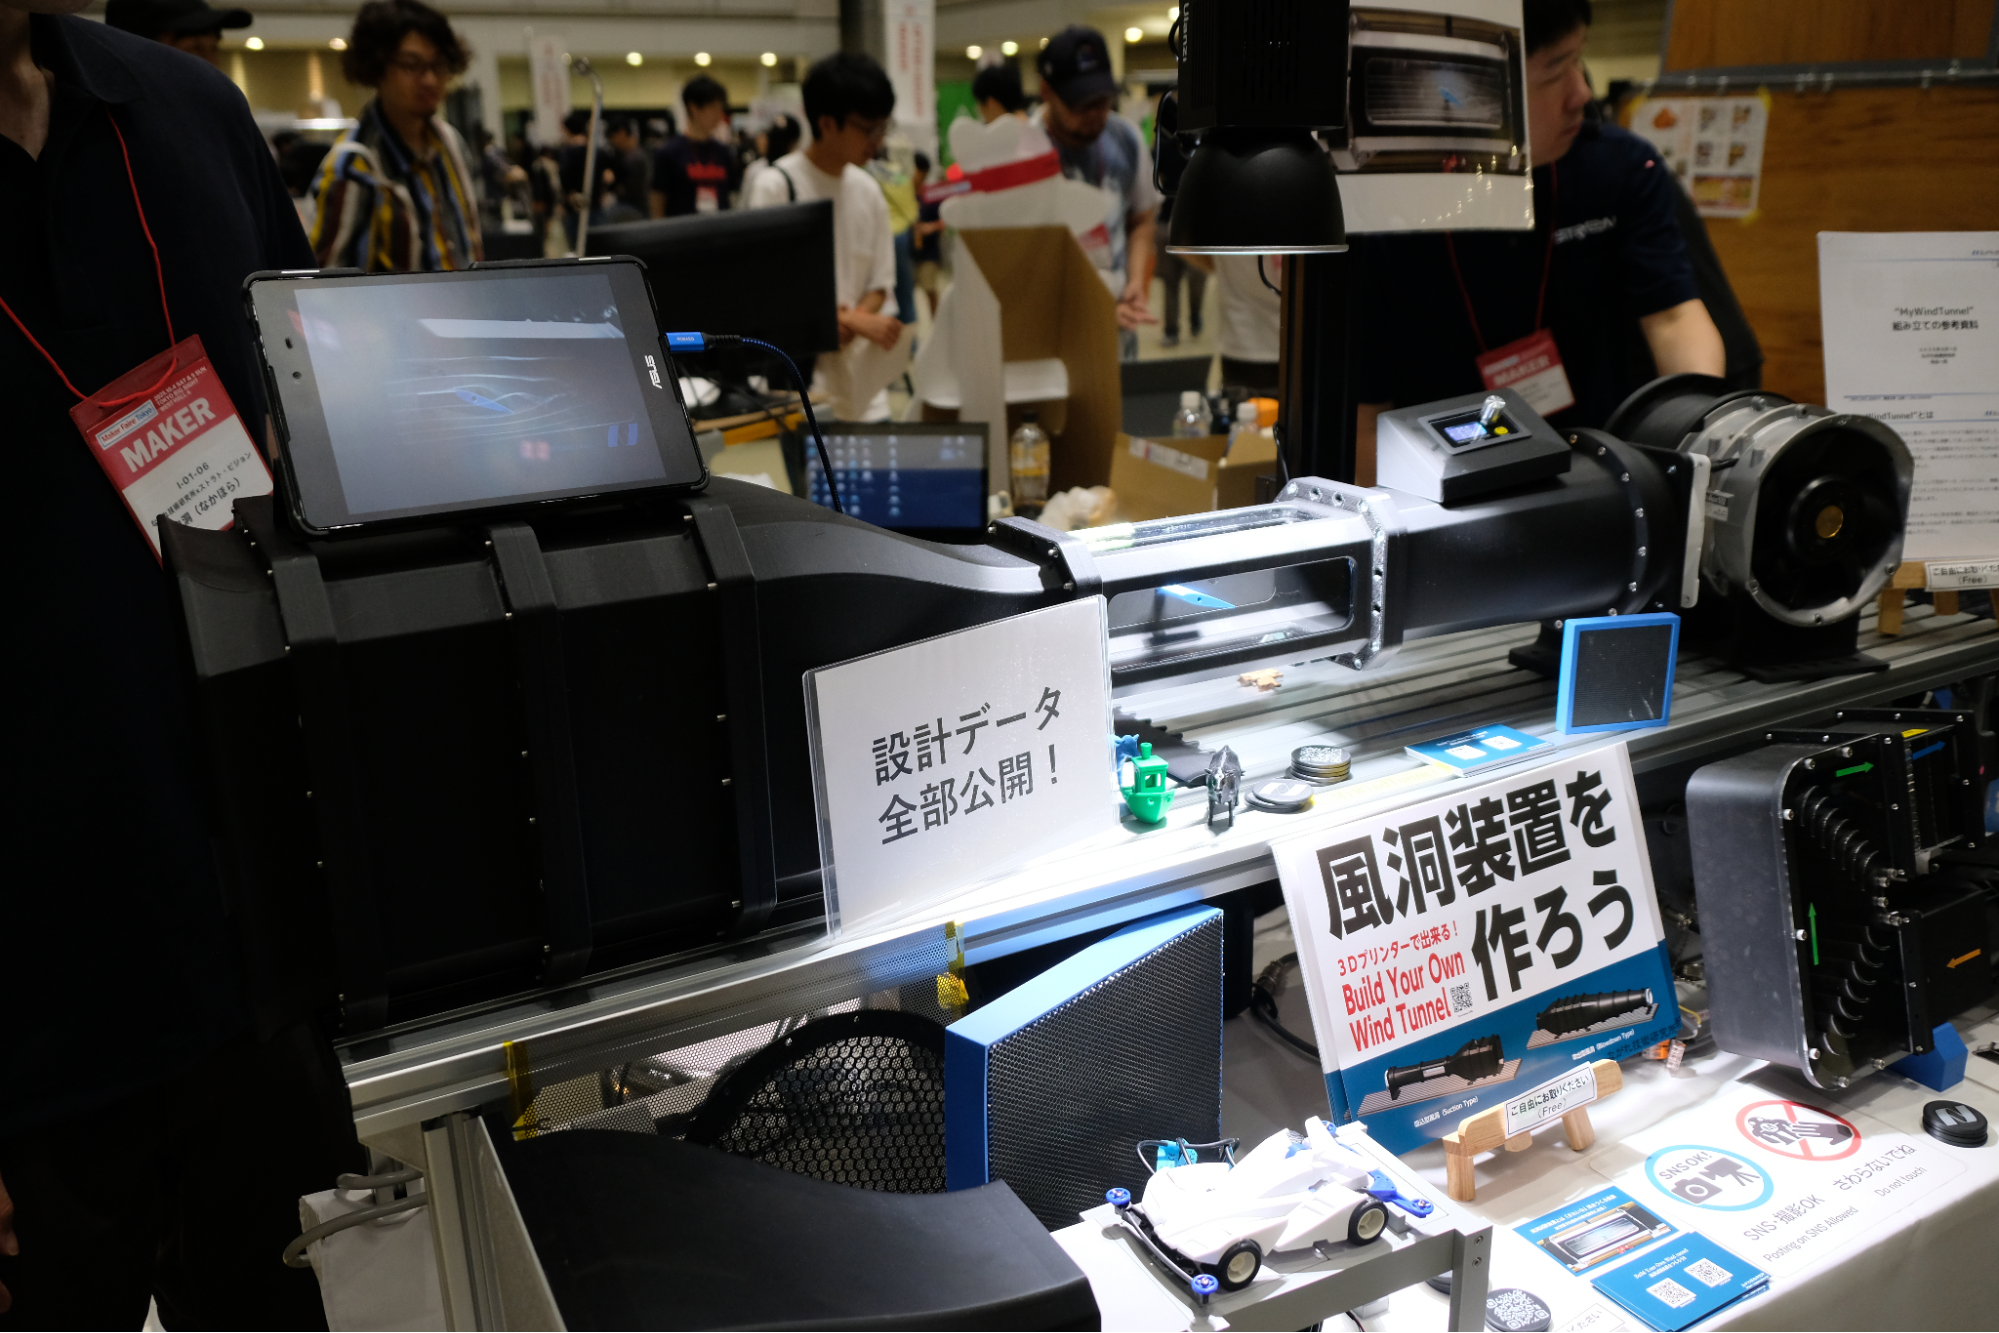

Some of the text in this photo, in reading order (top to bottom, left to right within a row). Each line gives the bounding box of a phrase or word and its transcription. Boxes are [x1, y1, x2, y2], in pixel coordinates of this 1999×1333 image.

[156, 392, 174, 406] TOKYO
[644, 355, 662, 390] ASUS
[101, 407, 153, 443] Maker Faire Tokyo
[119, 397, 216, 473] MAKER
[872, 686, 1061, 786] 設計データ
[878, 743, 1058, 845] 全部公開！
[1315, 770, 1617, 941] 風洞装置を
[1471, 869, 1634, 1002] 作ろう
[1342, 951, 1466, 1016] Build Your Own
[1349, 987, 1452, 1052] Wind Tunnel
[1442, 1103, 1463, 1117] (Suction
[1463, 1096, 1479, 1108] Type)
[1511, 1074, 1589, 1117] ご自由にお取りください
[1832, 1144, 1917, 1191] さわらないでね
[1874, 1166, 1928, 1197] Do not touch
[1762, 1205, 1859, 1262] Posting on SNS Allowed
